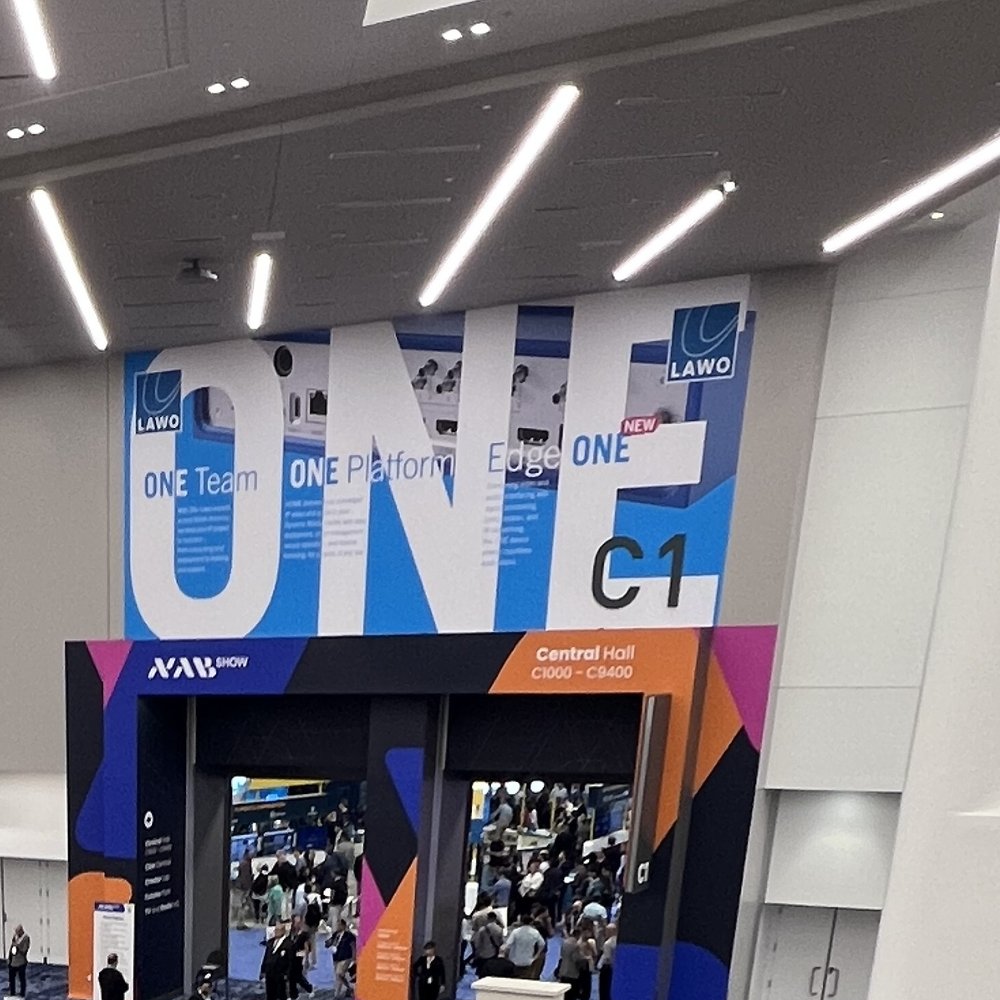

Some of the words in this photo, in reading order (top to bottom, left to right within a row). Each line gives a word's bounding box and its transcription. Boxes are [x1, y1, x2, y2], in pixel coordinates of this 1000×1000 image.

[671, 356, 733, 379] LAWO
[137, 414, 180, 431] LAWO
[623, 418, 658, 433] NEW
[130, 274, 750, 640] ONE
[488, 440, 562, 478] Edge
[572, 433, 630, 466] ONE
[290, 457, 339, 488] ONE
[347, 450, 457, 484] Platform
[144, 469, 188, 498] ONE
[194, 466, 258, 496] Team
[591, 533, 687, 609] C1
[536, 645, 601, 661] Central
[603, 644, 636, 660] Hall
[147, 656, 217, 679] NAB
[215, 656, 249, 668] SHOW
[531, 666, 573, 679] C1000
